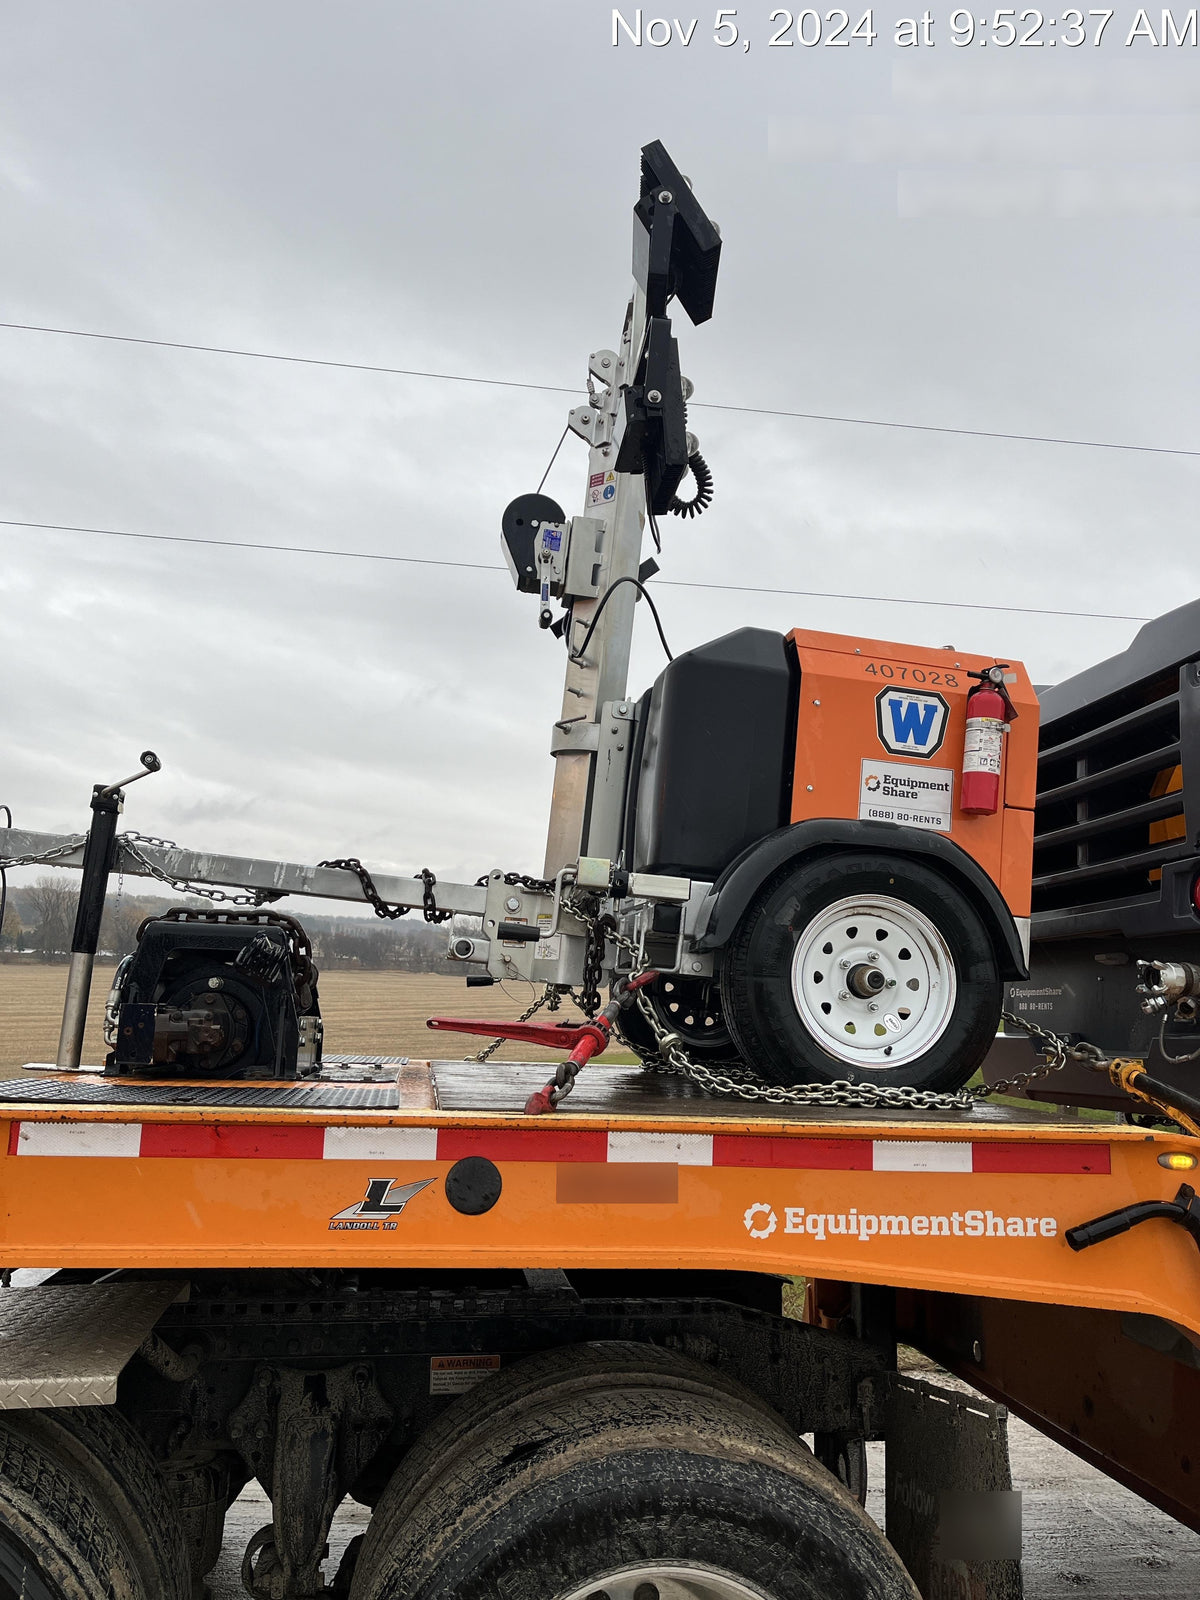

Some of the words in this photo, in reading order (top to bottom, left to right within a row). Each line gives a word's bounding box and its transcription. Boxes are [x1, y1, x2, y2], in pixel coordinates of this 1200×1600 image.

[865, 663, 959, 688] 407028
[888, 698, 938, 746] W
[882, 774, 950, 792] Equipment
[882, 785, 919, 799] Share
[868, 808, 894, 820] (888)
[896, 810, 942, 825] 80-RENTS
[1015, 987, 1062, 997] EquipmentShare
[328, 1221, 380, 1231] LANDOLL
[783, 1206, 1058, 1241] EquipmentShare
[446, 1358, 493, 1368] WARNING
